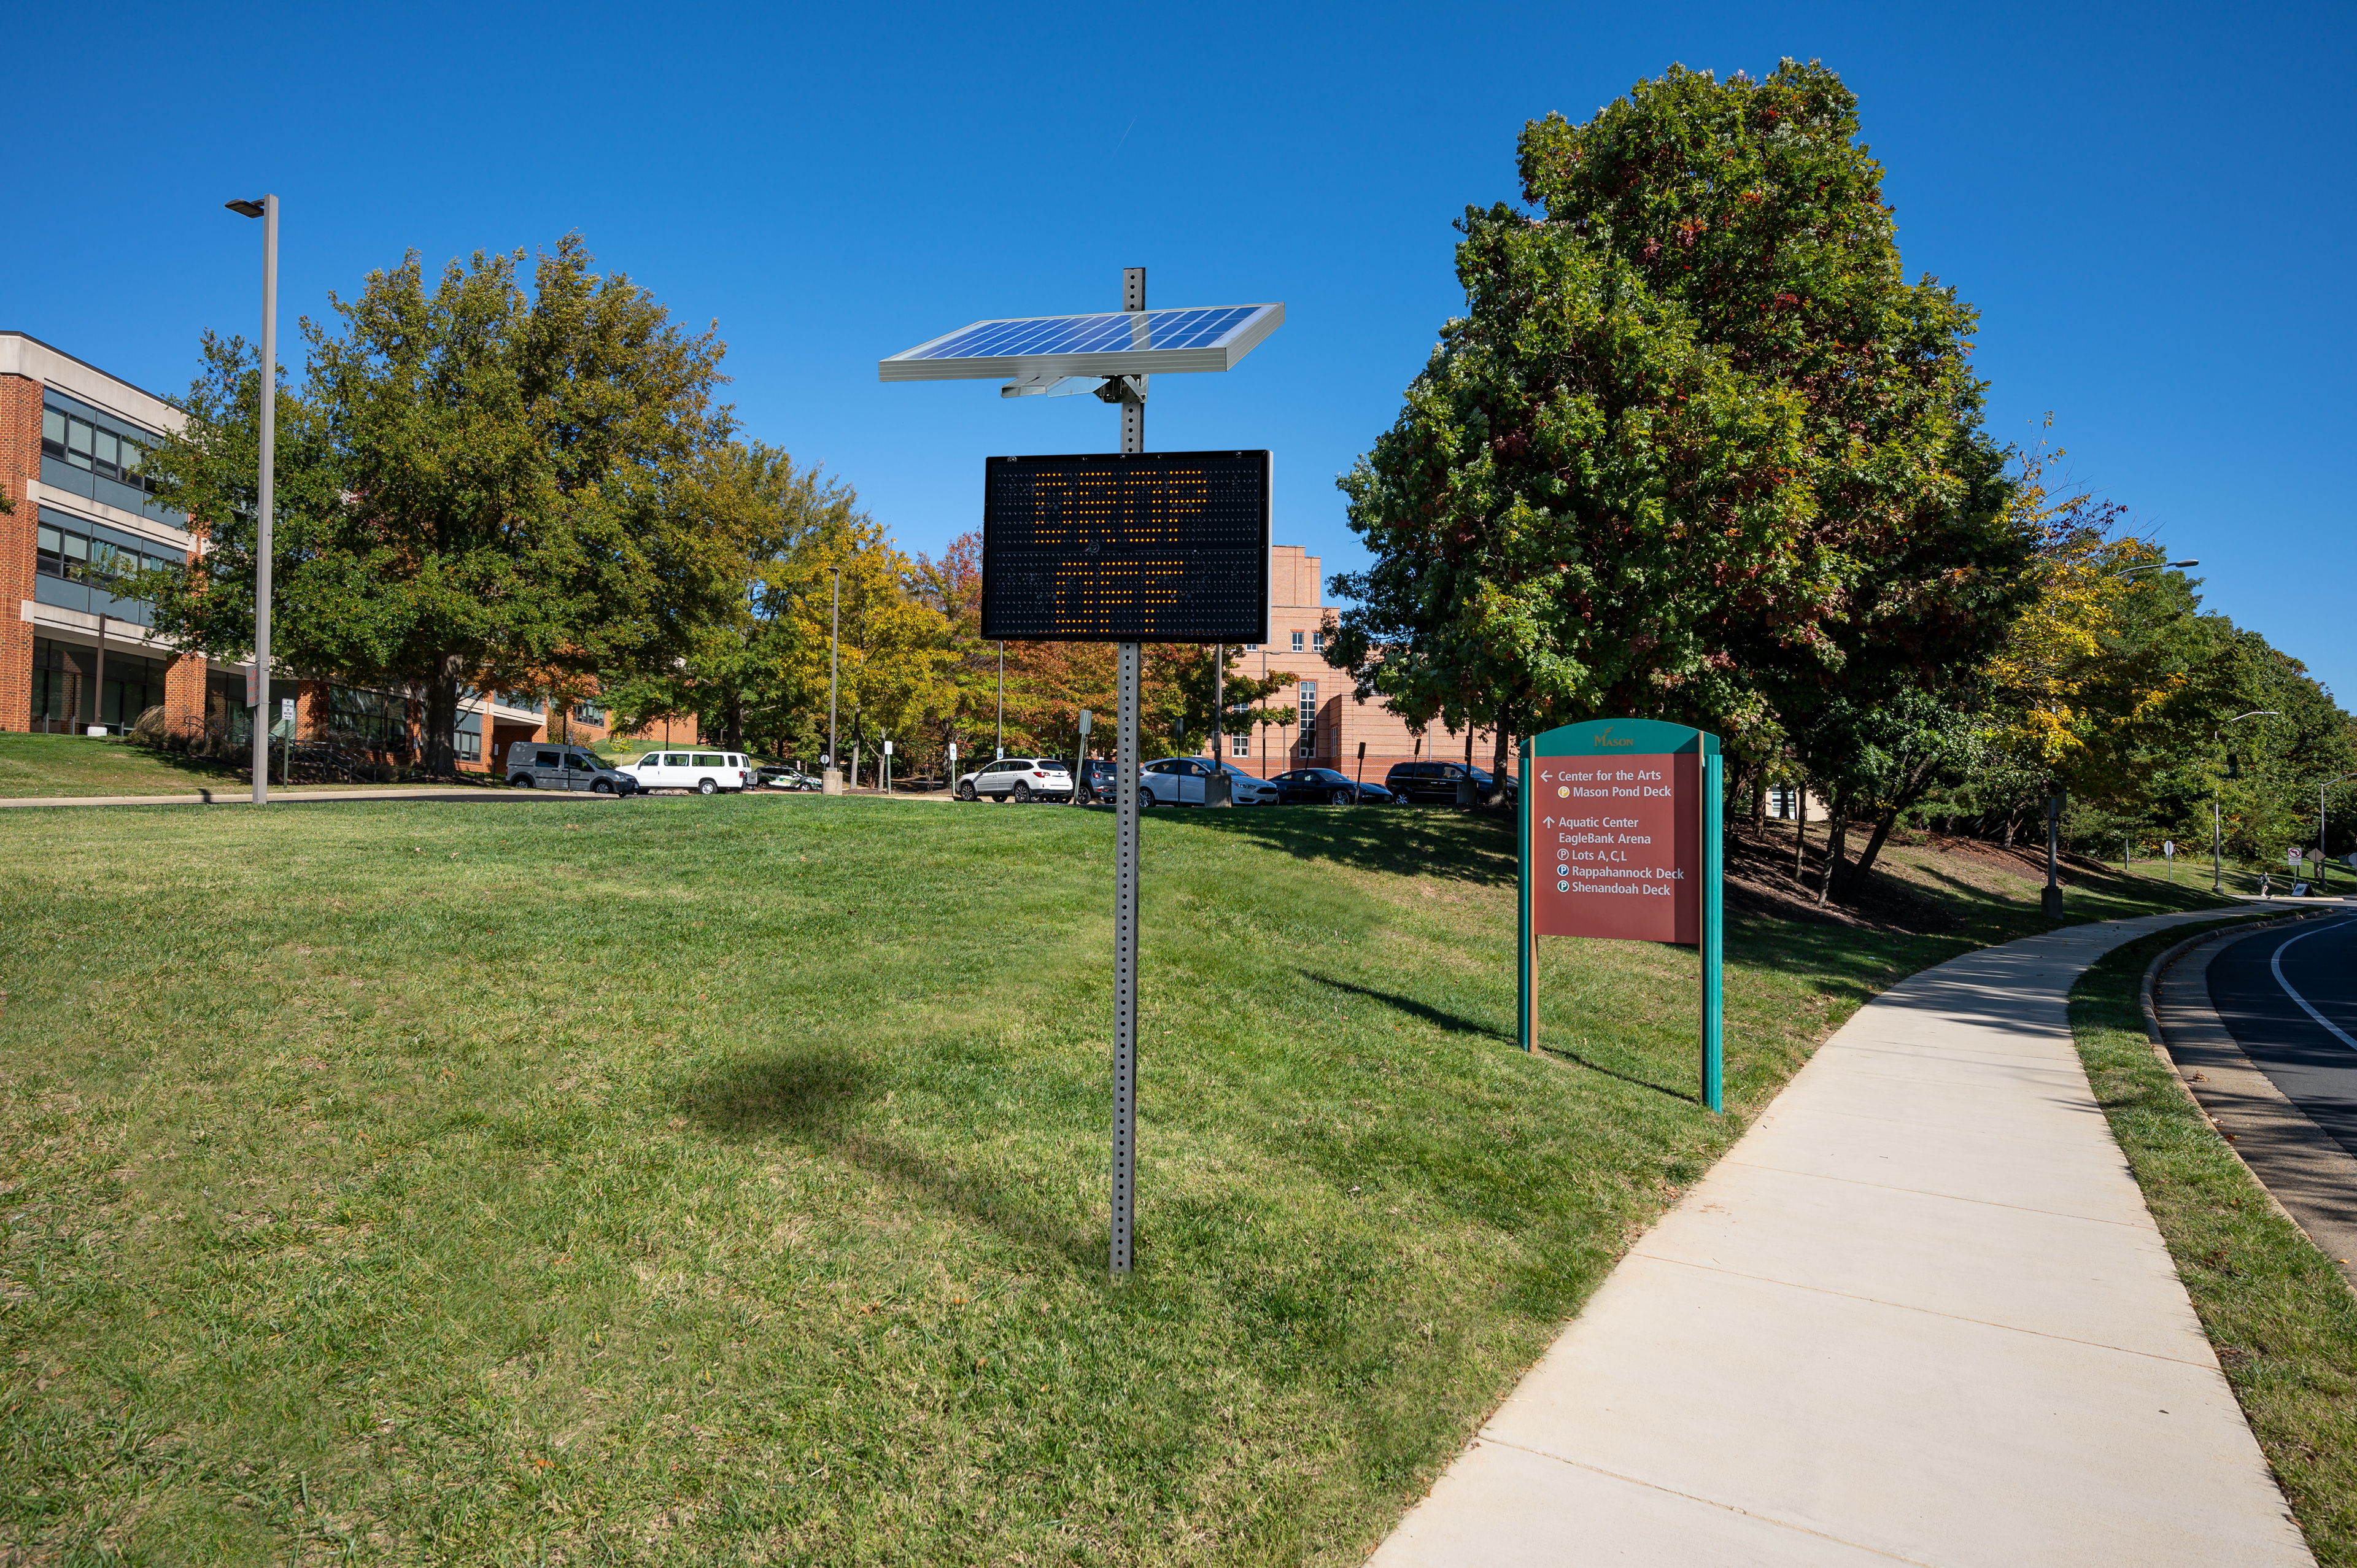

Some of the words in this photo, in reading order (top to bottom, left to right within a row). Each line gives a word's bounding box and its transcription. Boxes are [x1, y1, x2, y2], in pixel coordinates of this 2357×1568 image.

[1035, 471, 1207, 543] DROP
[1056, 561, 1183, 633] OFF
[1558, 771, 1593, 781] Center
[1596, 770, 1612, 781] for
[1616, 770, 1634, 781] the
[1637, 770, 1662, 780] Arts
[1573, 787, 1609, 797] Mason
[1612, 786, 1640, 797] Pond
[1643, 786, 1672, 797] Deck
[1558, 817, 1600, 830] Aquatic
[1602, 817, 1639, 828] Center
[1558, 832, 1615, 846] EagleBank
[1617, 833, 1651, 844] Arena
[1572, 850, 1595, 860] Lots
[1572, 866, 1652, 879] Rappahannock
[1656, 868, 1685, 880] Deck
[1572, 881, 1639, 894] Shenandoah
[1643, 884, 1671, 895] Deck
